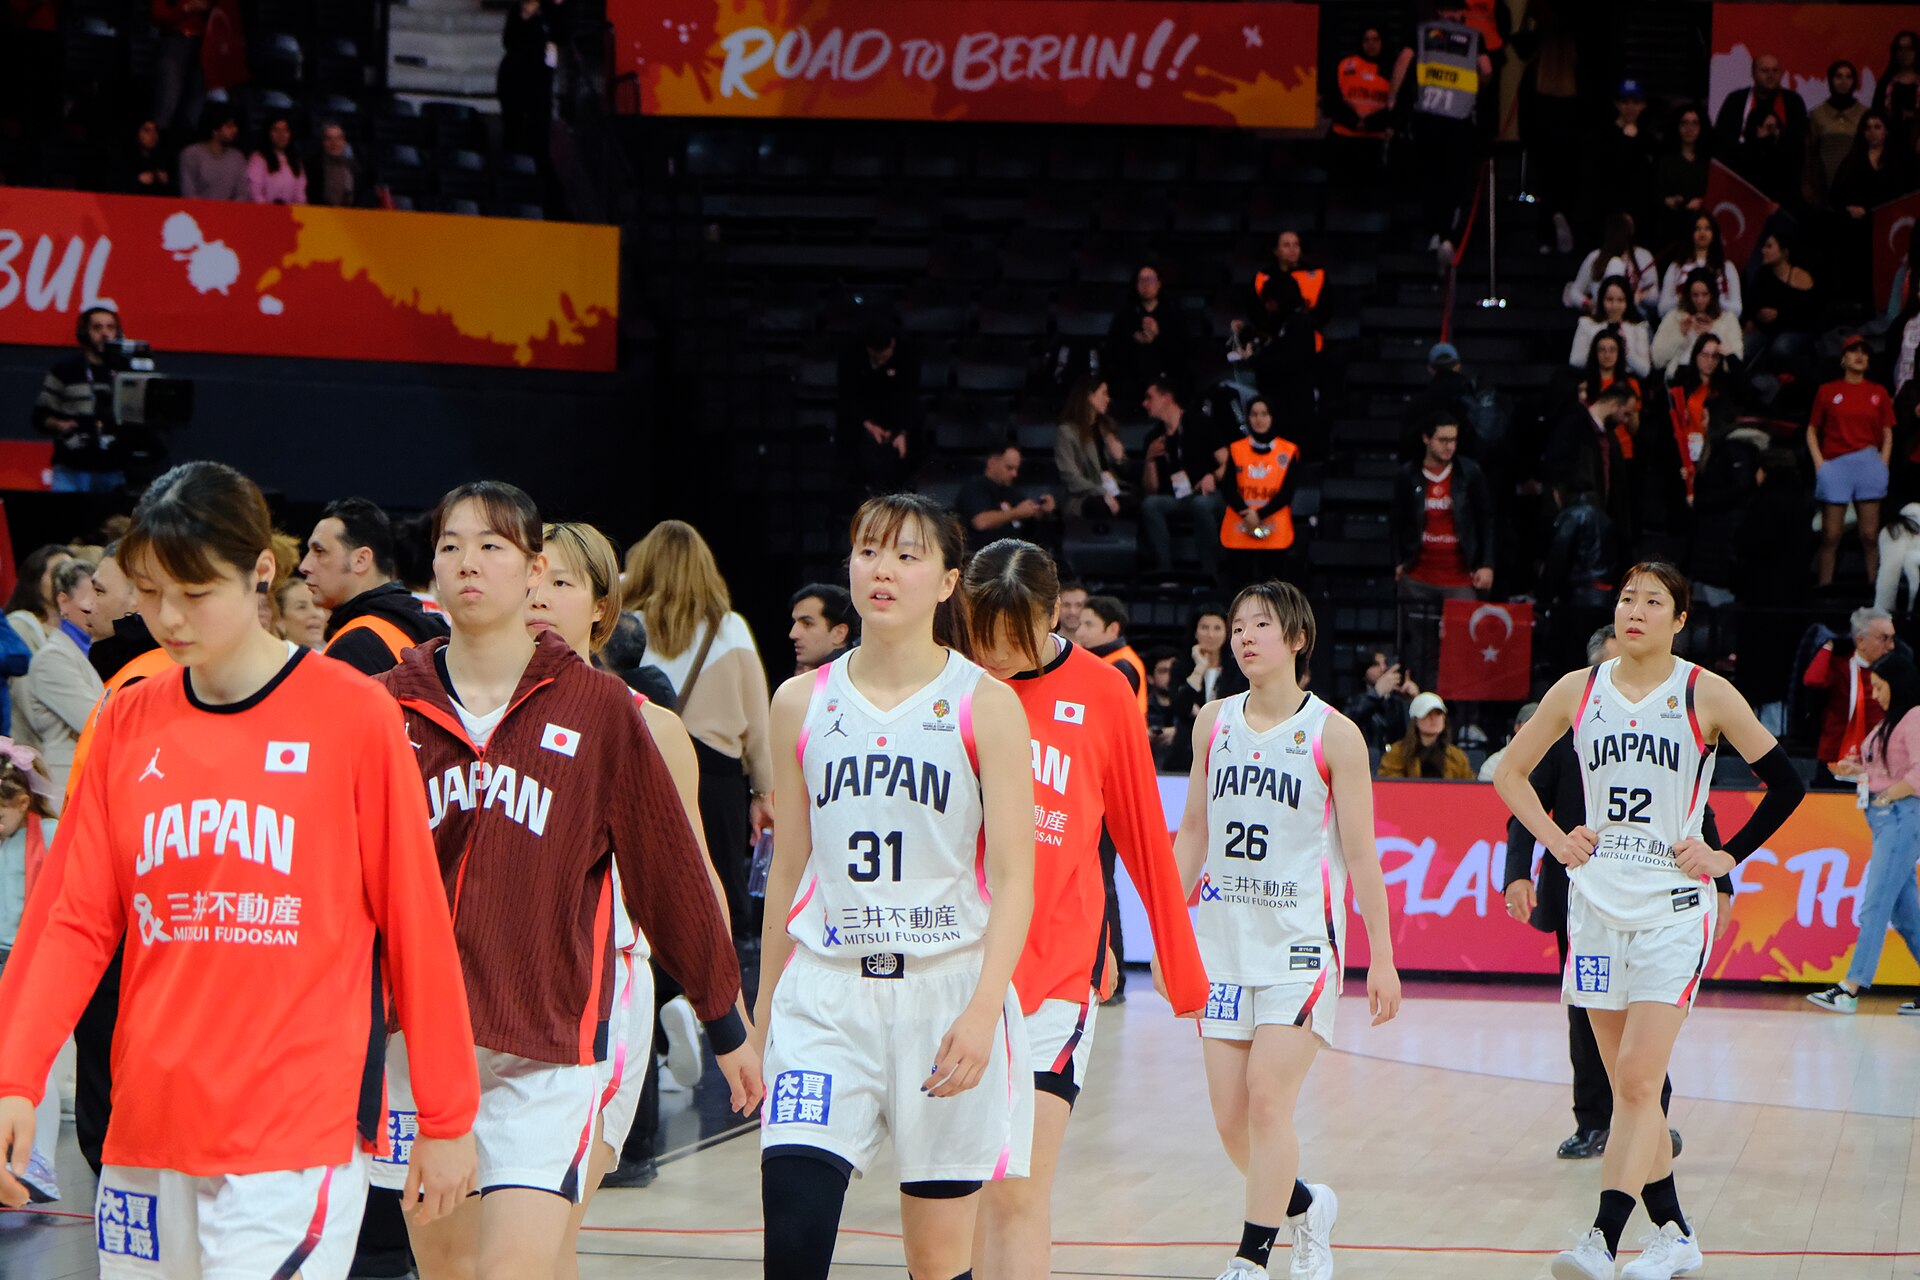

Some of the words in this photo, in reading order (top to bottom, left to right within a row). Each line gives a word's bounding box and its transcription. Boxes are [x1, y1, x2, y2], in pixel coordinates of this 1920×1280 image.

[720, 26, 892, 99] ROAD
[901, 38, 945, 80] TO
[952, 18, 1199, 91] BERLIN!!
[1588, 733, 1680, 772] JAPAN
[428, 761, 553, 837] JAPAN
[816, 754, 951, 815] JAPAN
[1213, 765, 1302, 810] JAPAN
[1607, 786, 1652, 823] 52
[136, 798, 295, 876] JAPAN
[1225, 821, 1269, 862] 26
[1600, 850, 1629, 861] MITSUI
[848, 831, 903, 882] 31
[1222, 874, 1298, 898] 三井不動産
[1252, 896, 1298, 909] FUDOSAN
[167, 890, 302, 925] 三井不動産
[841, 904, 958, 930] 三井不動産
[214, 926, 299, 946] FUDOSAN
[843, 931, 890, 945] MITSUI
[896, 929, 961, 945] FUDOSAN
